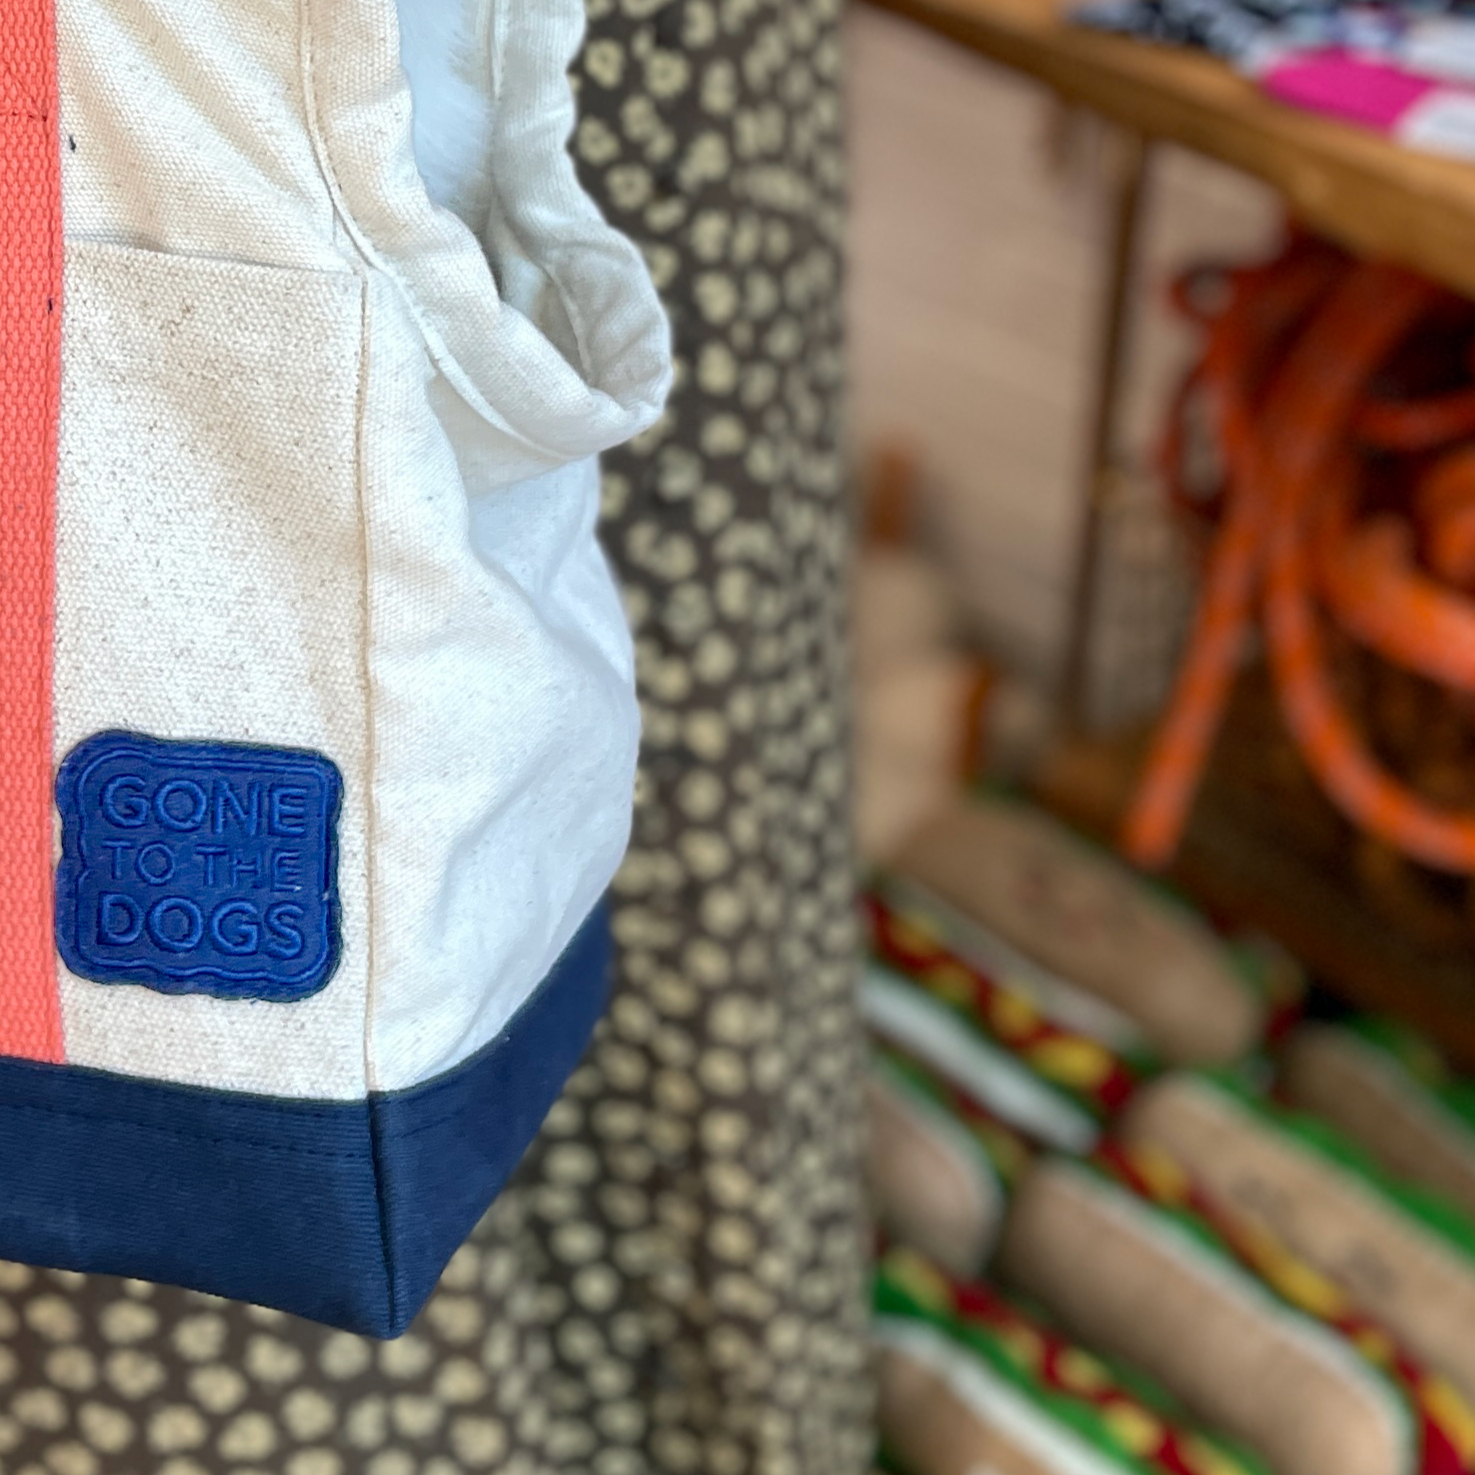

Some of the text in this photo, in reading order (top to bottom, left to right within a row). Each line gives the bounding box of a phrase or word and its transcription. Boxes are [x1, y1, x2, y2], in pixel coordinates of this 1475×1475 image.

[101, 774, 308, 837] GONE
[102, 839, 302, 892] TO THE
[99, 891, 305, 958] DOGS
